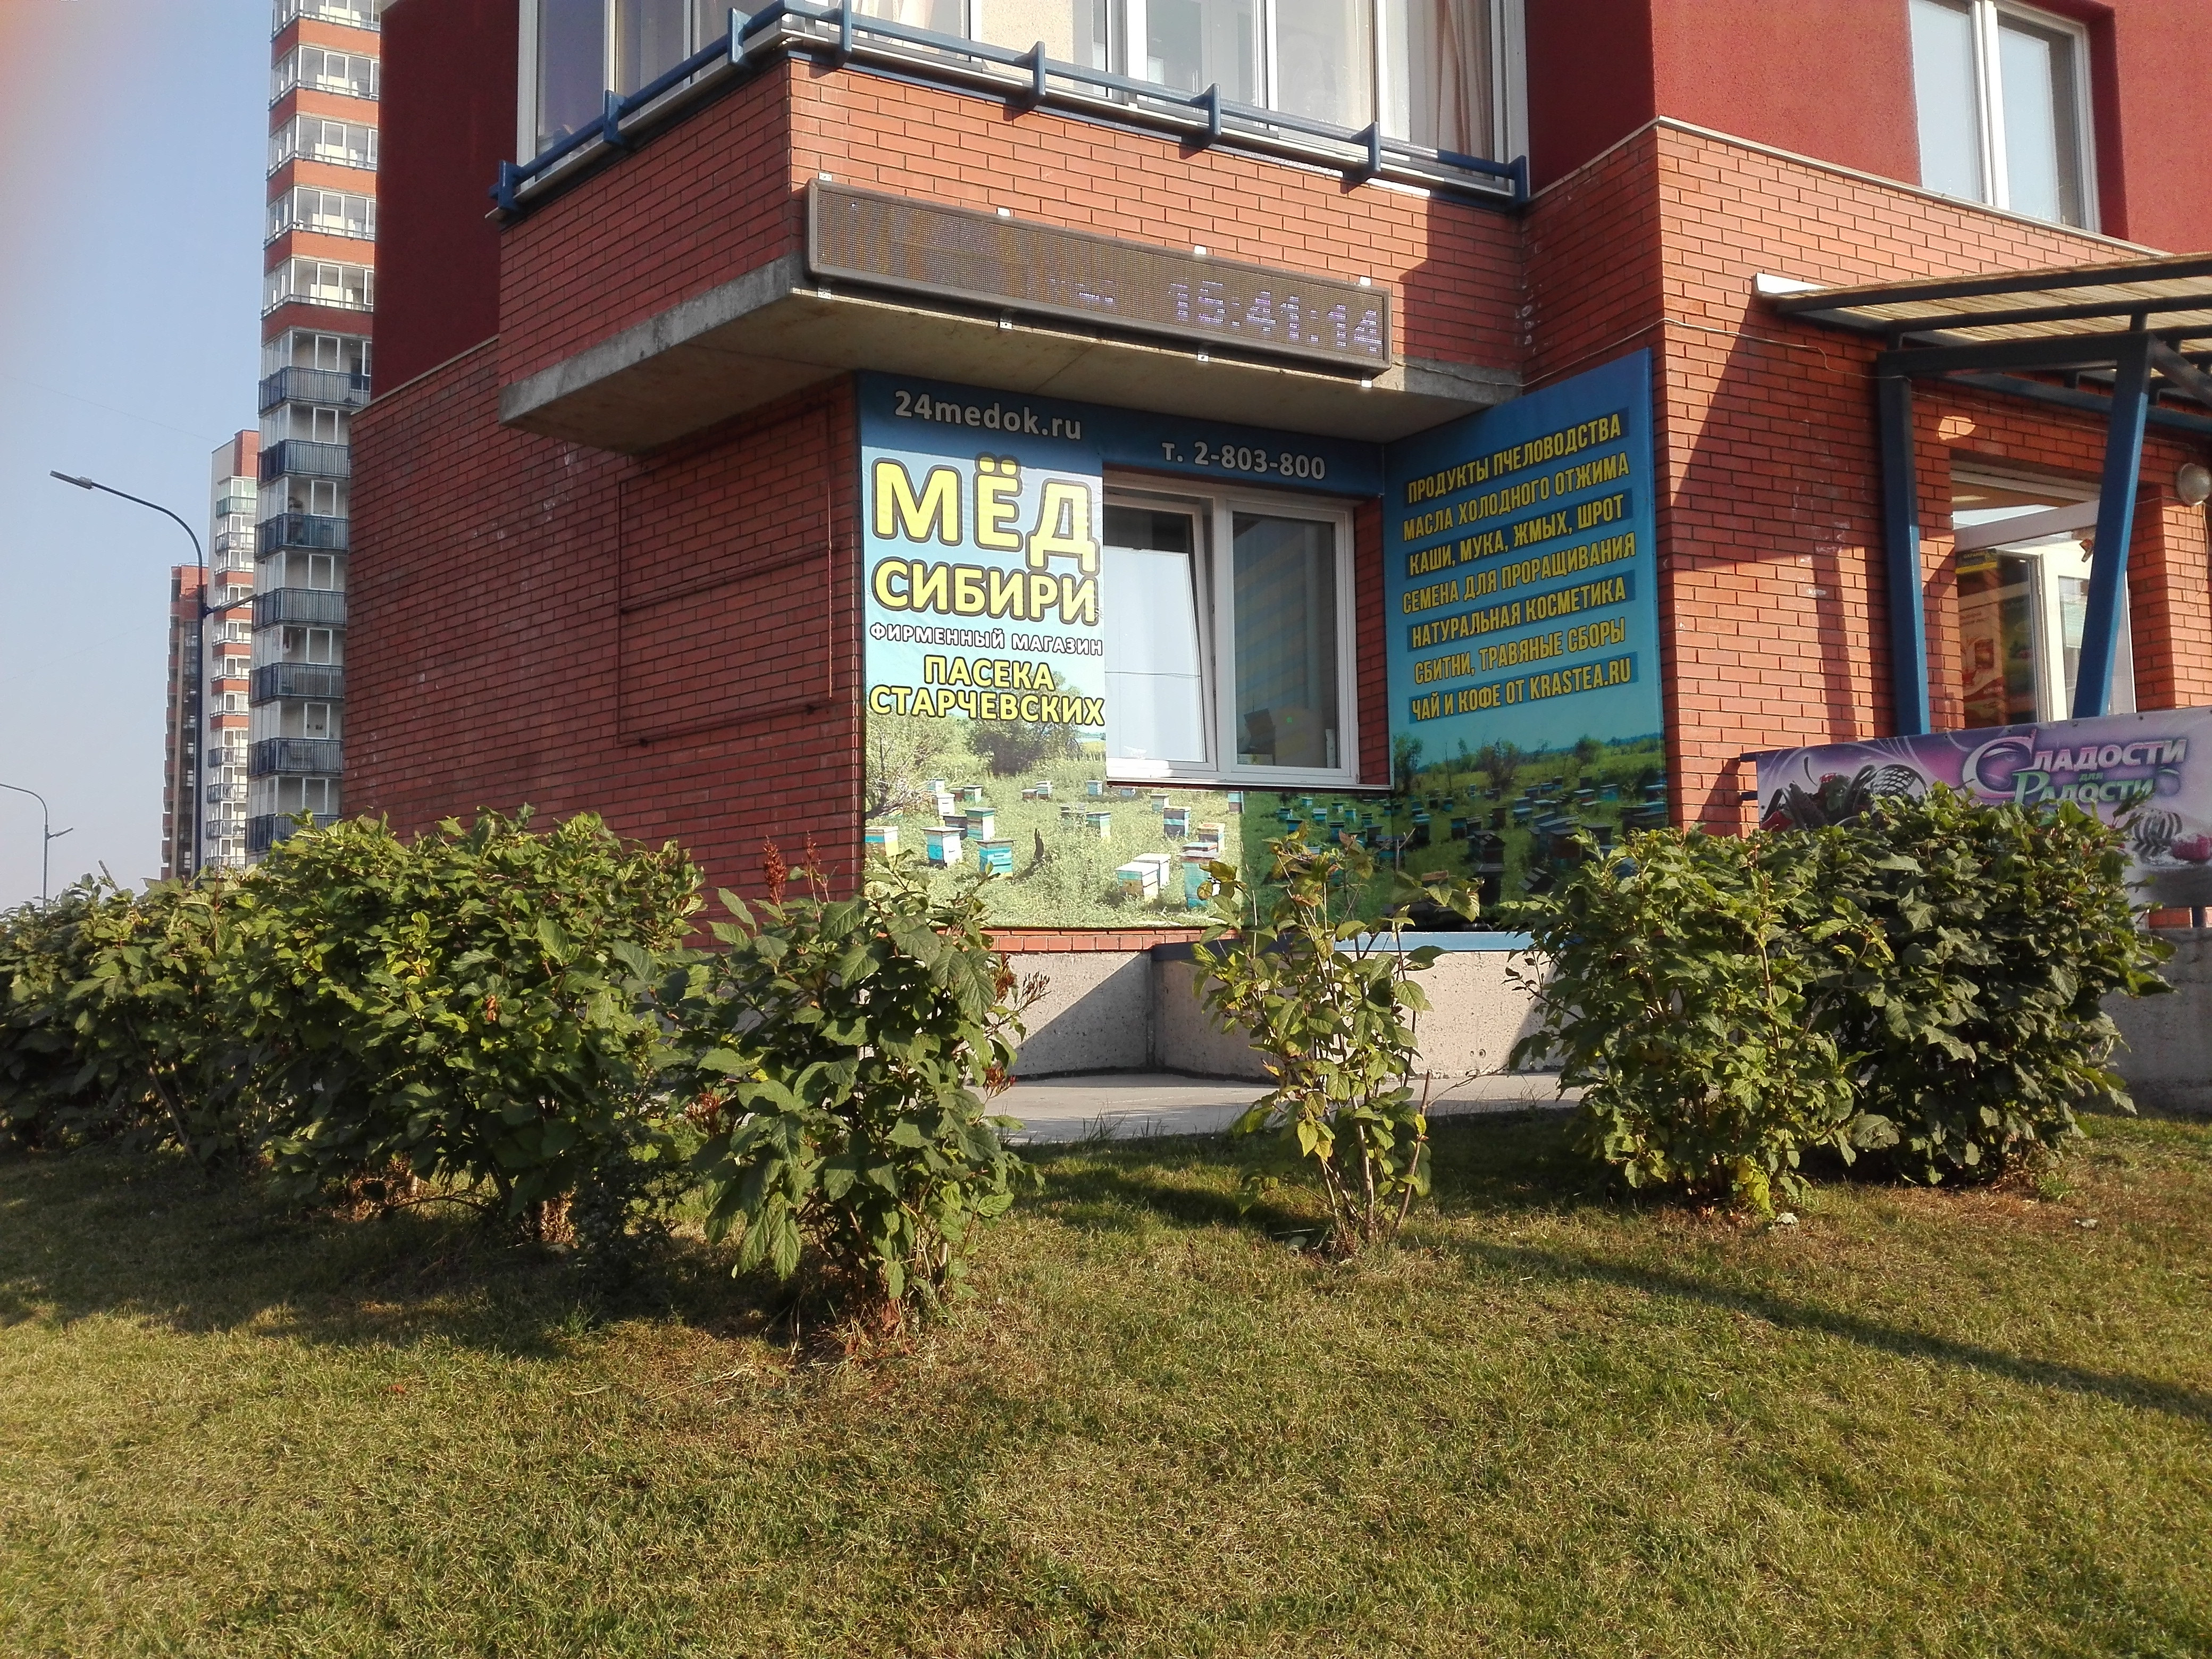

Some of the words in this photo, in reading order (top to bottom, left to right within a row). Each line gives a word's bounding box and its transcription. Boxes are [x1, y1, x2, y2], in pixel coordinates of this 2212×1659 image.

[895, 390, 1082, 440] 24medok.ru
[1194, 441, 1326, 480] 2-803-800
[1407, 457, 1488, 504] ПРОДУКТЫ
[1493, 413, 1621, 476] ПЧЕЛОВОДСТВА
[872, 451, 1103, 575] МЁД
[1403, 507, 1454, 542] МАСЛА
[1458, 476, 1550, 525] ХОЛОДНОГО
[1554, 452, 1630, 496] ОТЖИМА
[1409, 544, 1456, 576] КАШИ,
[1460, 529, 1509, 563] МУКА,
[1513, 510, 1572, 548] ЖМЫХ,
[1577, 493, 1624, 528] ШРОТ
[871, 557, 1102, 626] СИБИРИ
[1402, 580, 1459, 614] СЕМЕНА
[1463, 569, 1497, 602] ДЛЯ
[1501, 531, 1636, 590] ПРОРАЩИВАНИЯ
[869, 622, 1005, 649] ФИРМЕННЫЙ
[1011, 633, 1103, 656] МАГАЗИН
[1412, 601, 1521, 649] НАТУРАЛЬНАЯ
[1525, 576, 1627, 623] КОСМЕТИКА
[924, 655, 1055, 691] ПАСЕКА
[1414, 652, 1475, 685] СБИТНИ,
[1479, 631, 1564, 672] ТРАВЯНЫЕ
[1568, 617, 1626, 653] СБОРЫ
[869, 684, 1105, 726] СТАРЧЕВСКИХ
[1412, 691, 1440, 721] ЧАЙ
[1444, 695, 1454, 716] И
[1458, 683, 1502, 714] КОФЕ
[1506, 678, 1526, 705] ОТ
[1530, 657, 1632, 700] KRASTEA.RU
